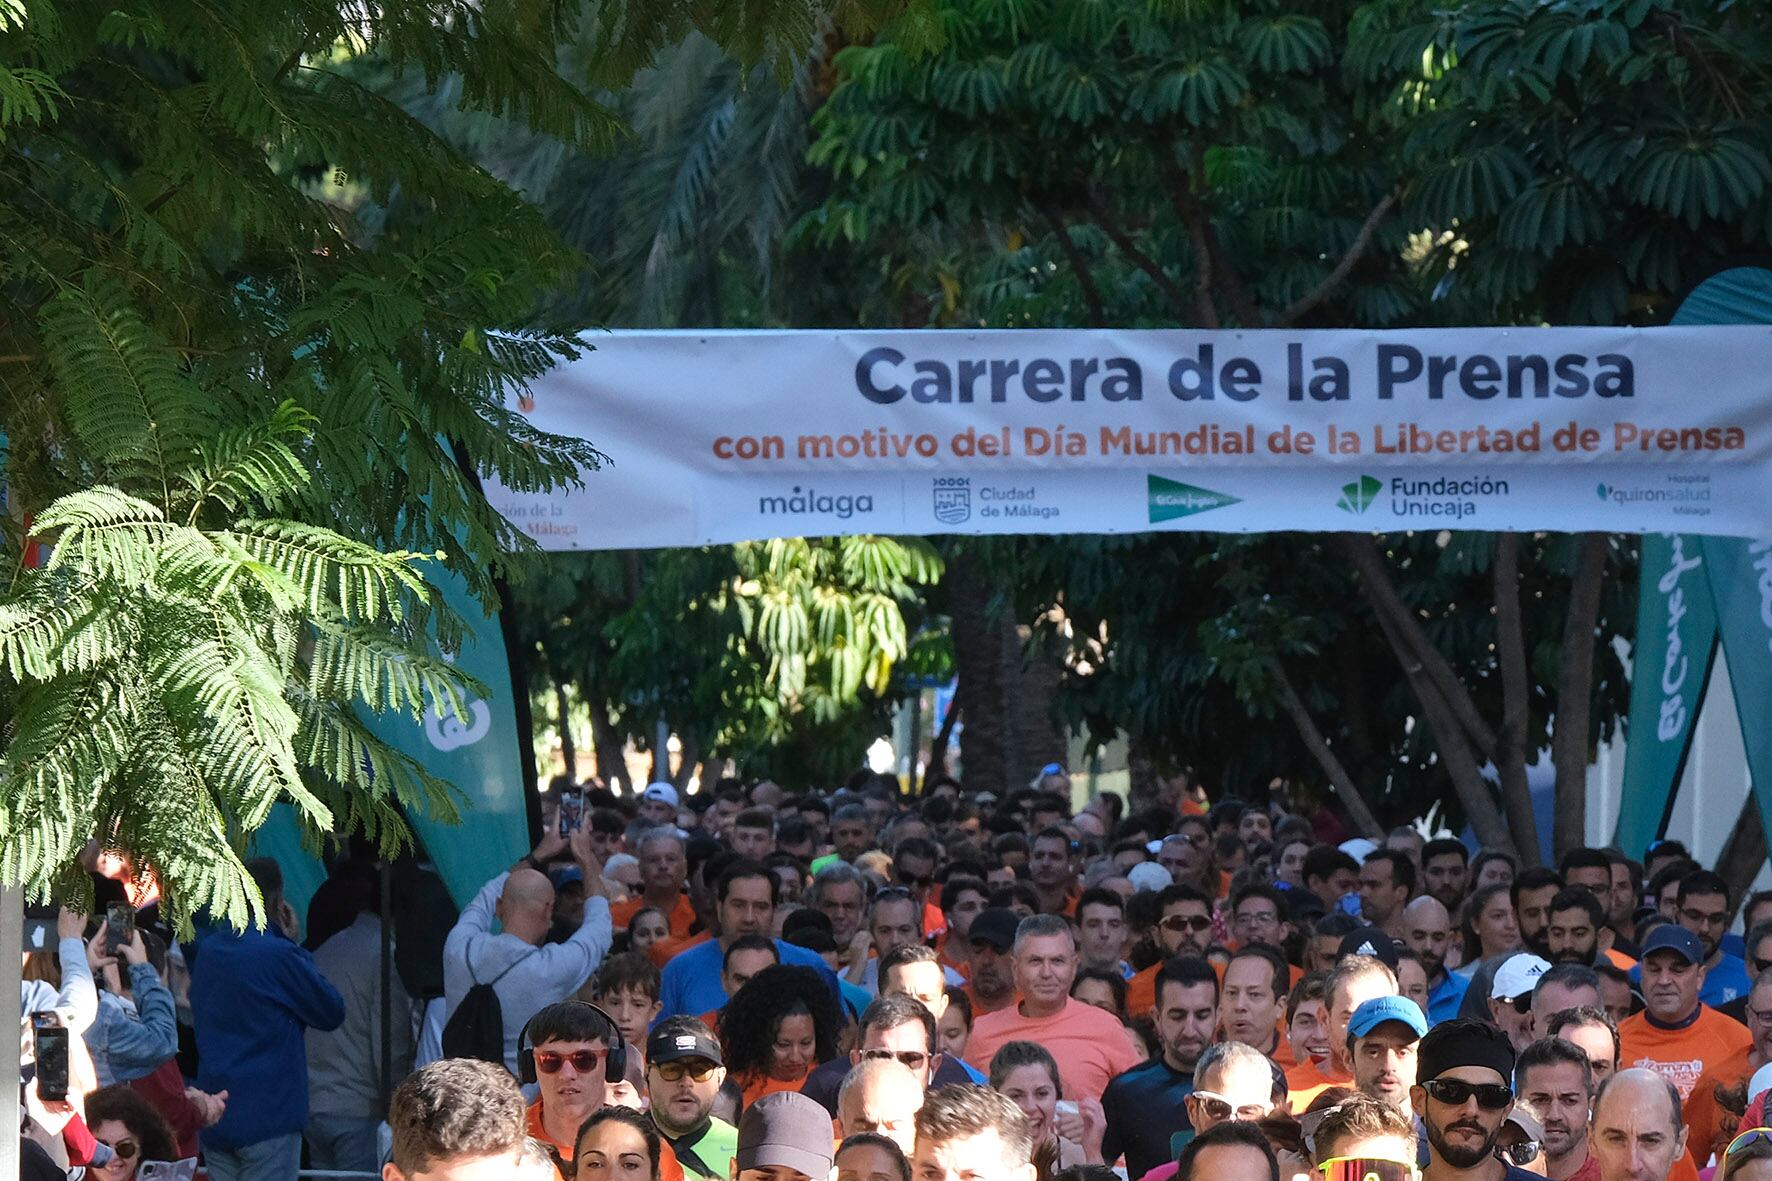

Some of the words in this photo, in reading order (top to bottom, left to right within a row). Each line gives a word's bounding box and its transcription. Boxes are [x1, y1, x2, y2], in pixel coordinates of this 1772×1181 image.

[855, 346, 1143, 404] Carrera
[1168, 343, 1262, 401] de
[1287, 343, 1350, 400] la
[1377, 343, 1635, 400] Prensa
[713, 435, 784, 459] con
[797, 427, 938, 459] motivo
[950, 426, 1010, 457] del
[1024, 424, 1086, 456] Día
[1100, 424, 1254, 455] Mundial
[1267, 425, 1316, 455] de
[1328, 424, 1360, 454] la
[1373, 422, 1540, 454] Libertad
[1554, 421, 1602, 452] de
[1614, 422, 1745, 452] Prensa
[979, 486, 1035, 501] Ciudad
[1391, 475, 1509, 496] Fundación
[979, 504, 999, 518] de
[1004, 503, 1060, 520] Málaga
[1392, 498, 1476, 520] Unicaja
